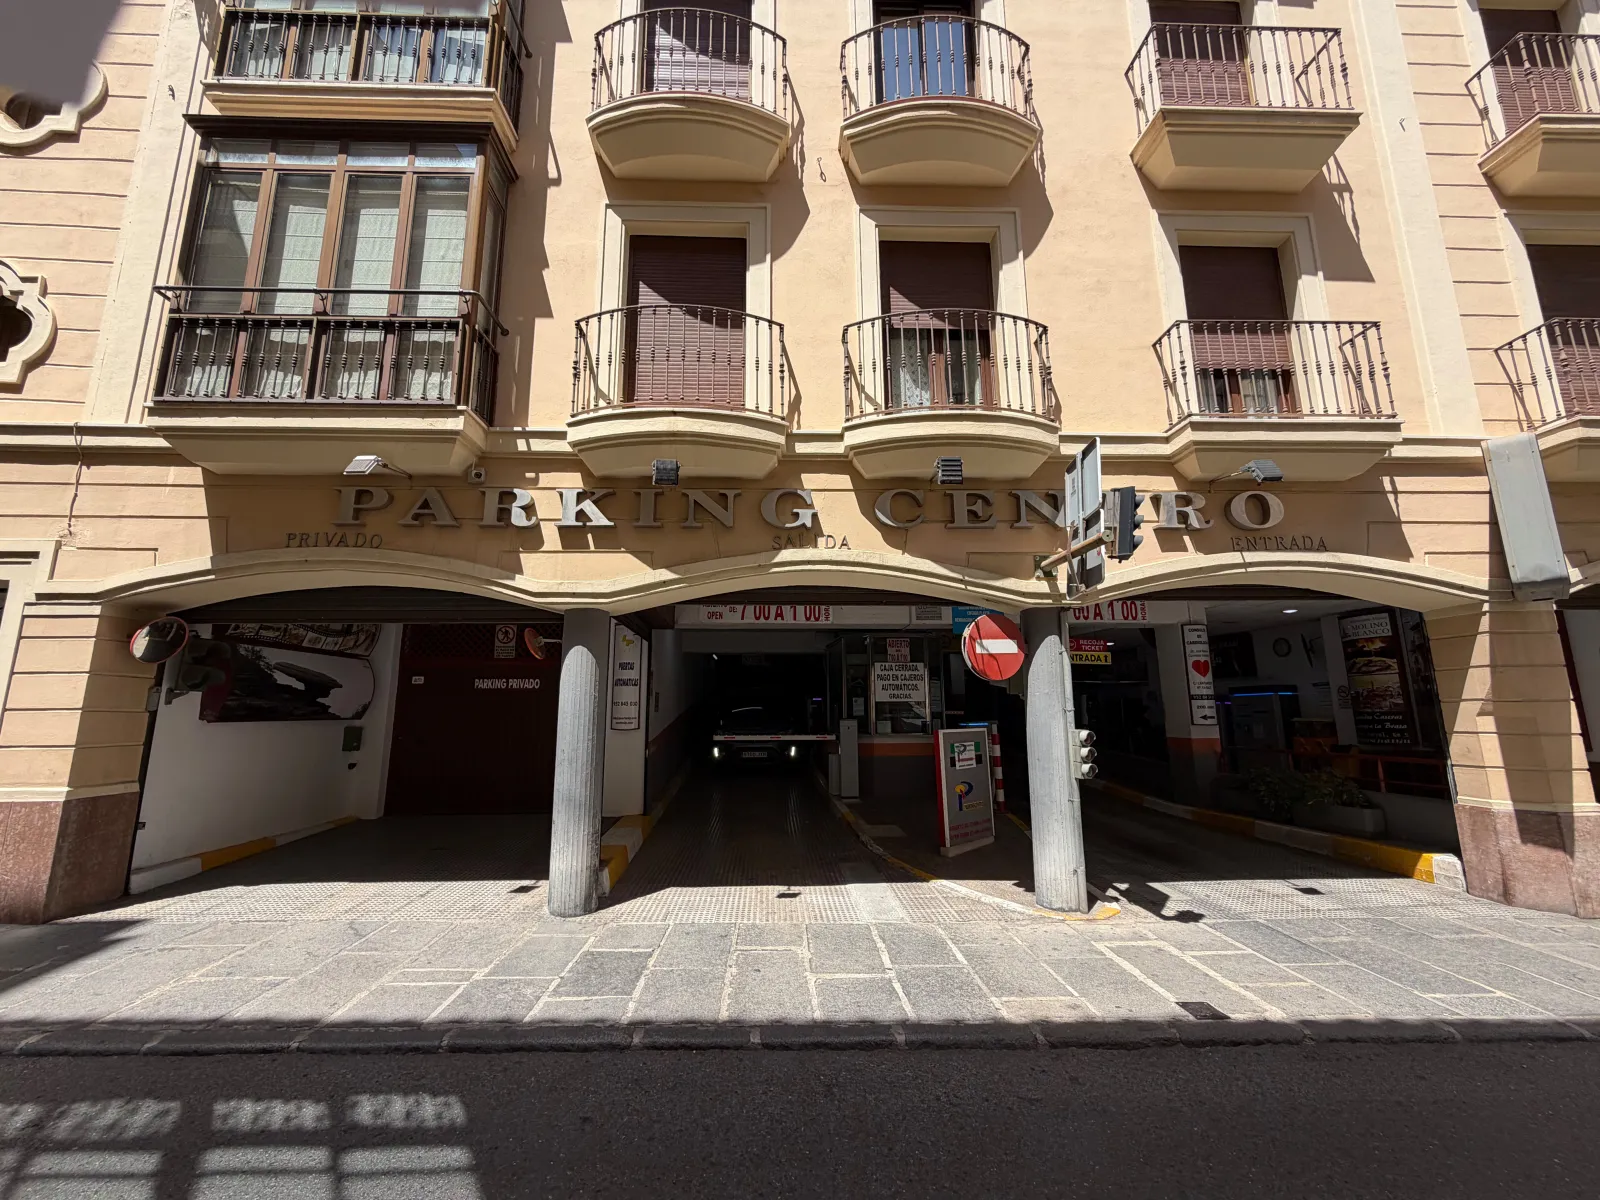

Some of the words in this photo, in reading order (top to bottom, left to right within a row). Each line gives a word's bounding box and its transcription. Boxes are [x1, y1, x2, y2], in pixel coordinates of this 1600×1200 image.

[331, 487, 818, 528] PARKING
[285, 532, 383, 548] PRIVADO
[772, 534, 851, 550] SALIDA
[1230, 534, 1330, 551] ENTRADA
[707, 611, 723, 620] OPEN
[1351, 621, 1388, 630] MOLINO
[1352, 628, 1390, 637] BLANCO
[888, 639, 910, 648] ABIERTO
[1070, 654, 1102, 663] NTRADA
[880, 664, 894, 672] CAJA
[901, 674, 924, 682] CAJEROS
[474, 679, 507, 689] PARKING
[508, 679, 541, 690] PRIVADO
